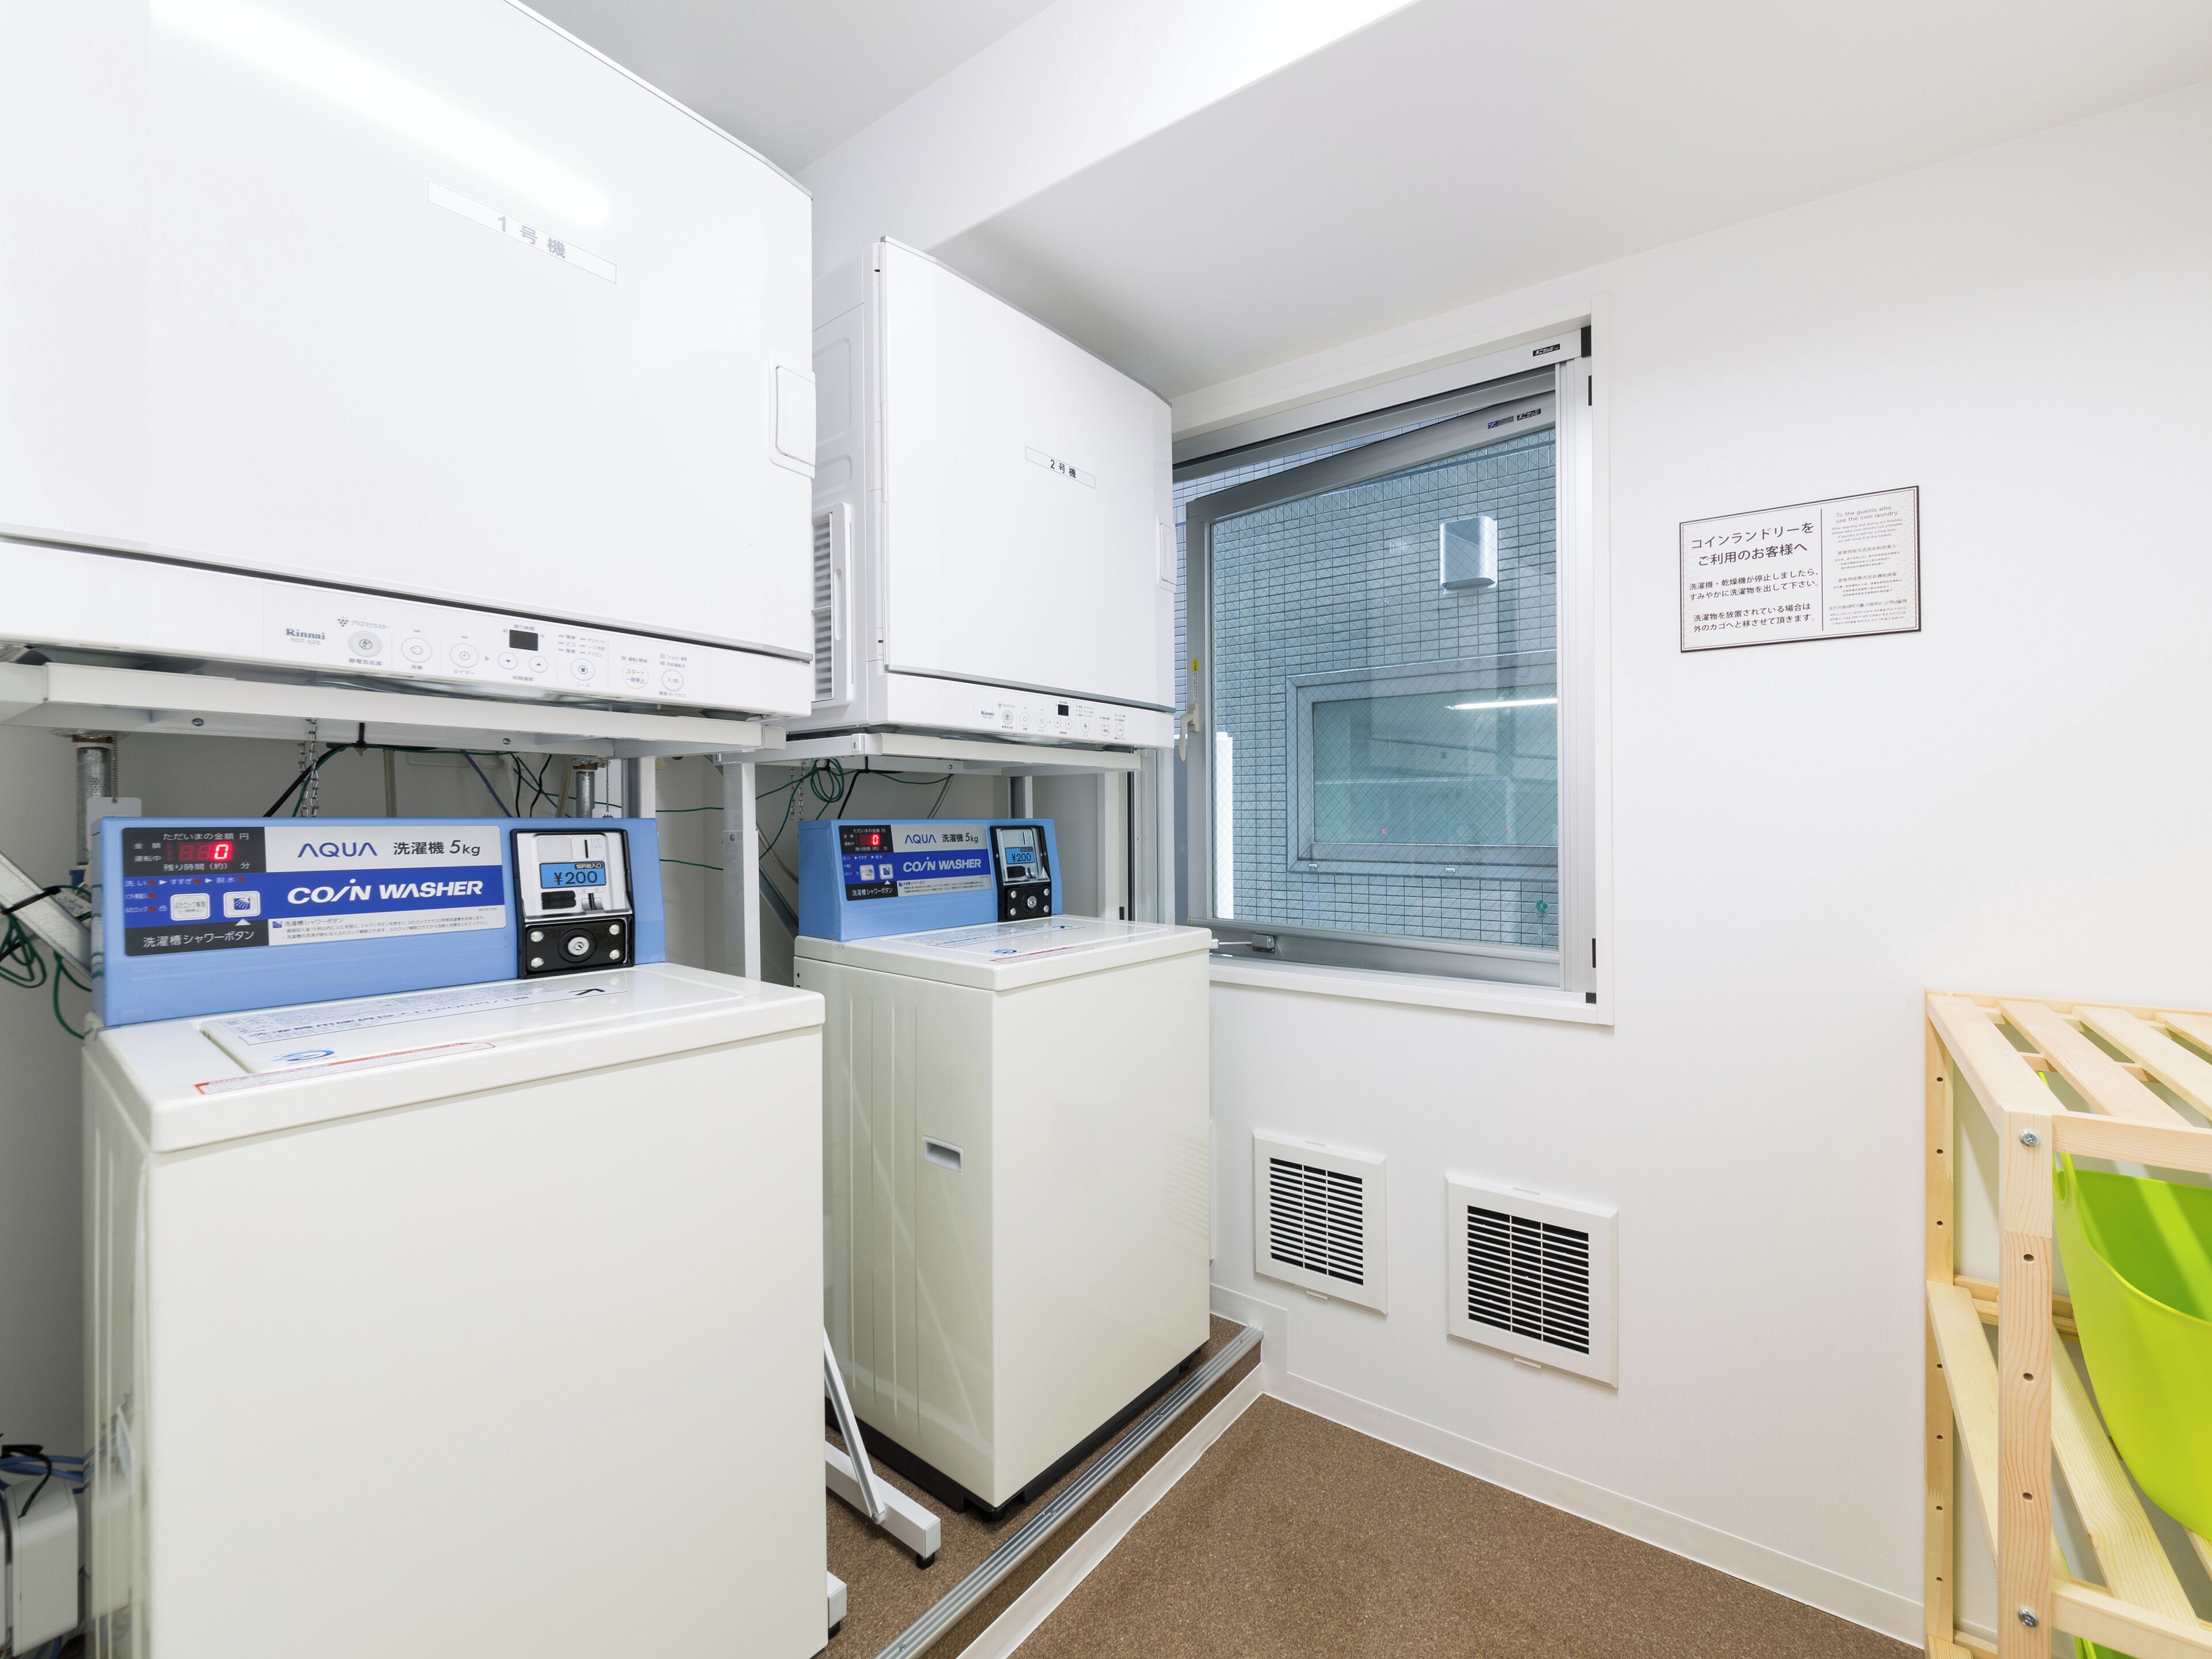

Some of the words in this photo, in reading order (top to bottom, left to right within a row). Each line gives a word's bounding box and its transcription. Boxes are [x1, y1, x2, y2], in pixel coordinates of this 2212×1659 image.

[498, 216, 566, 259] 1号機
[1051, 459, 1076, 479] 2号機
[1692, 522, 1814, 549] コインランドリーを
[1699, 543, 1807, 566] ご利用のお客様へ
[1689, 568, 1819, 590] 洗濯機・乾燥機が停止しましたら、
[1690, 579, 1819, 601] すみやかに洗濯物を出して下さい。
[1694, 603, 1810, 622] 洗濯物を放置されている場合は
[1694, 613, 1815, 632] 外のカゴへと移させて頂きます。
[286, 628, 325, 639] Rinnai
[905, 834, 937, 844] AQUA
[942, 834, 963, 843] 洗濯機
[965, 832, 978, 843] 5kg
[297, 842, 377, 858] AQUA
[393, 841, 444, 856] 洗濯機
[449, 839, 480, 857] 5kg
[938, 858, 981, 870] WASHER
[1012, 853, 1031, 862] ¥200
[554, 871, 597, 885] ¥200
[379, 881, 483, 899] WASHER
[852, 888, 893, 896] 洗濯槽シャワーボタン
[284, 918, 344, 926] 洗濯槽シャワーボタン
[143, 931, 254, 948] 洗濯槽シャワーボタン
